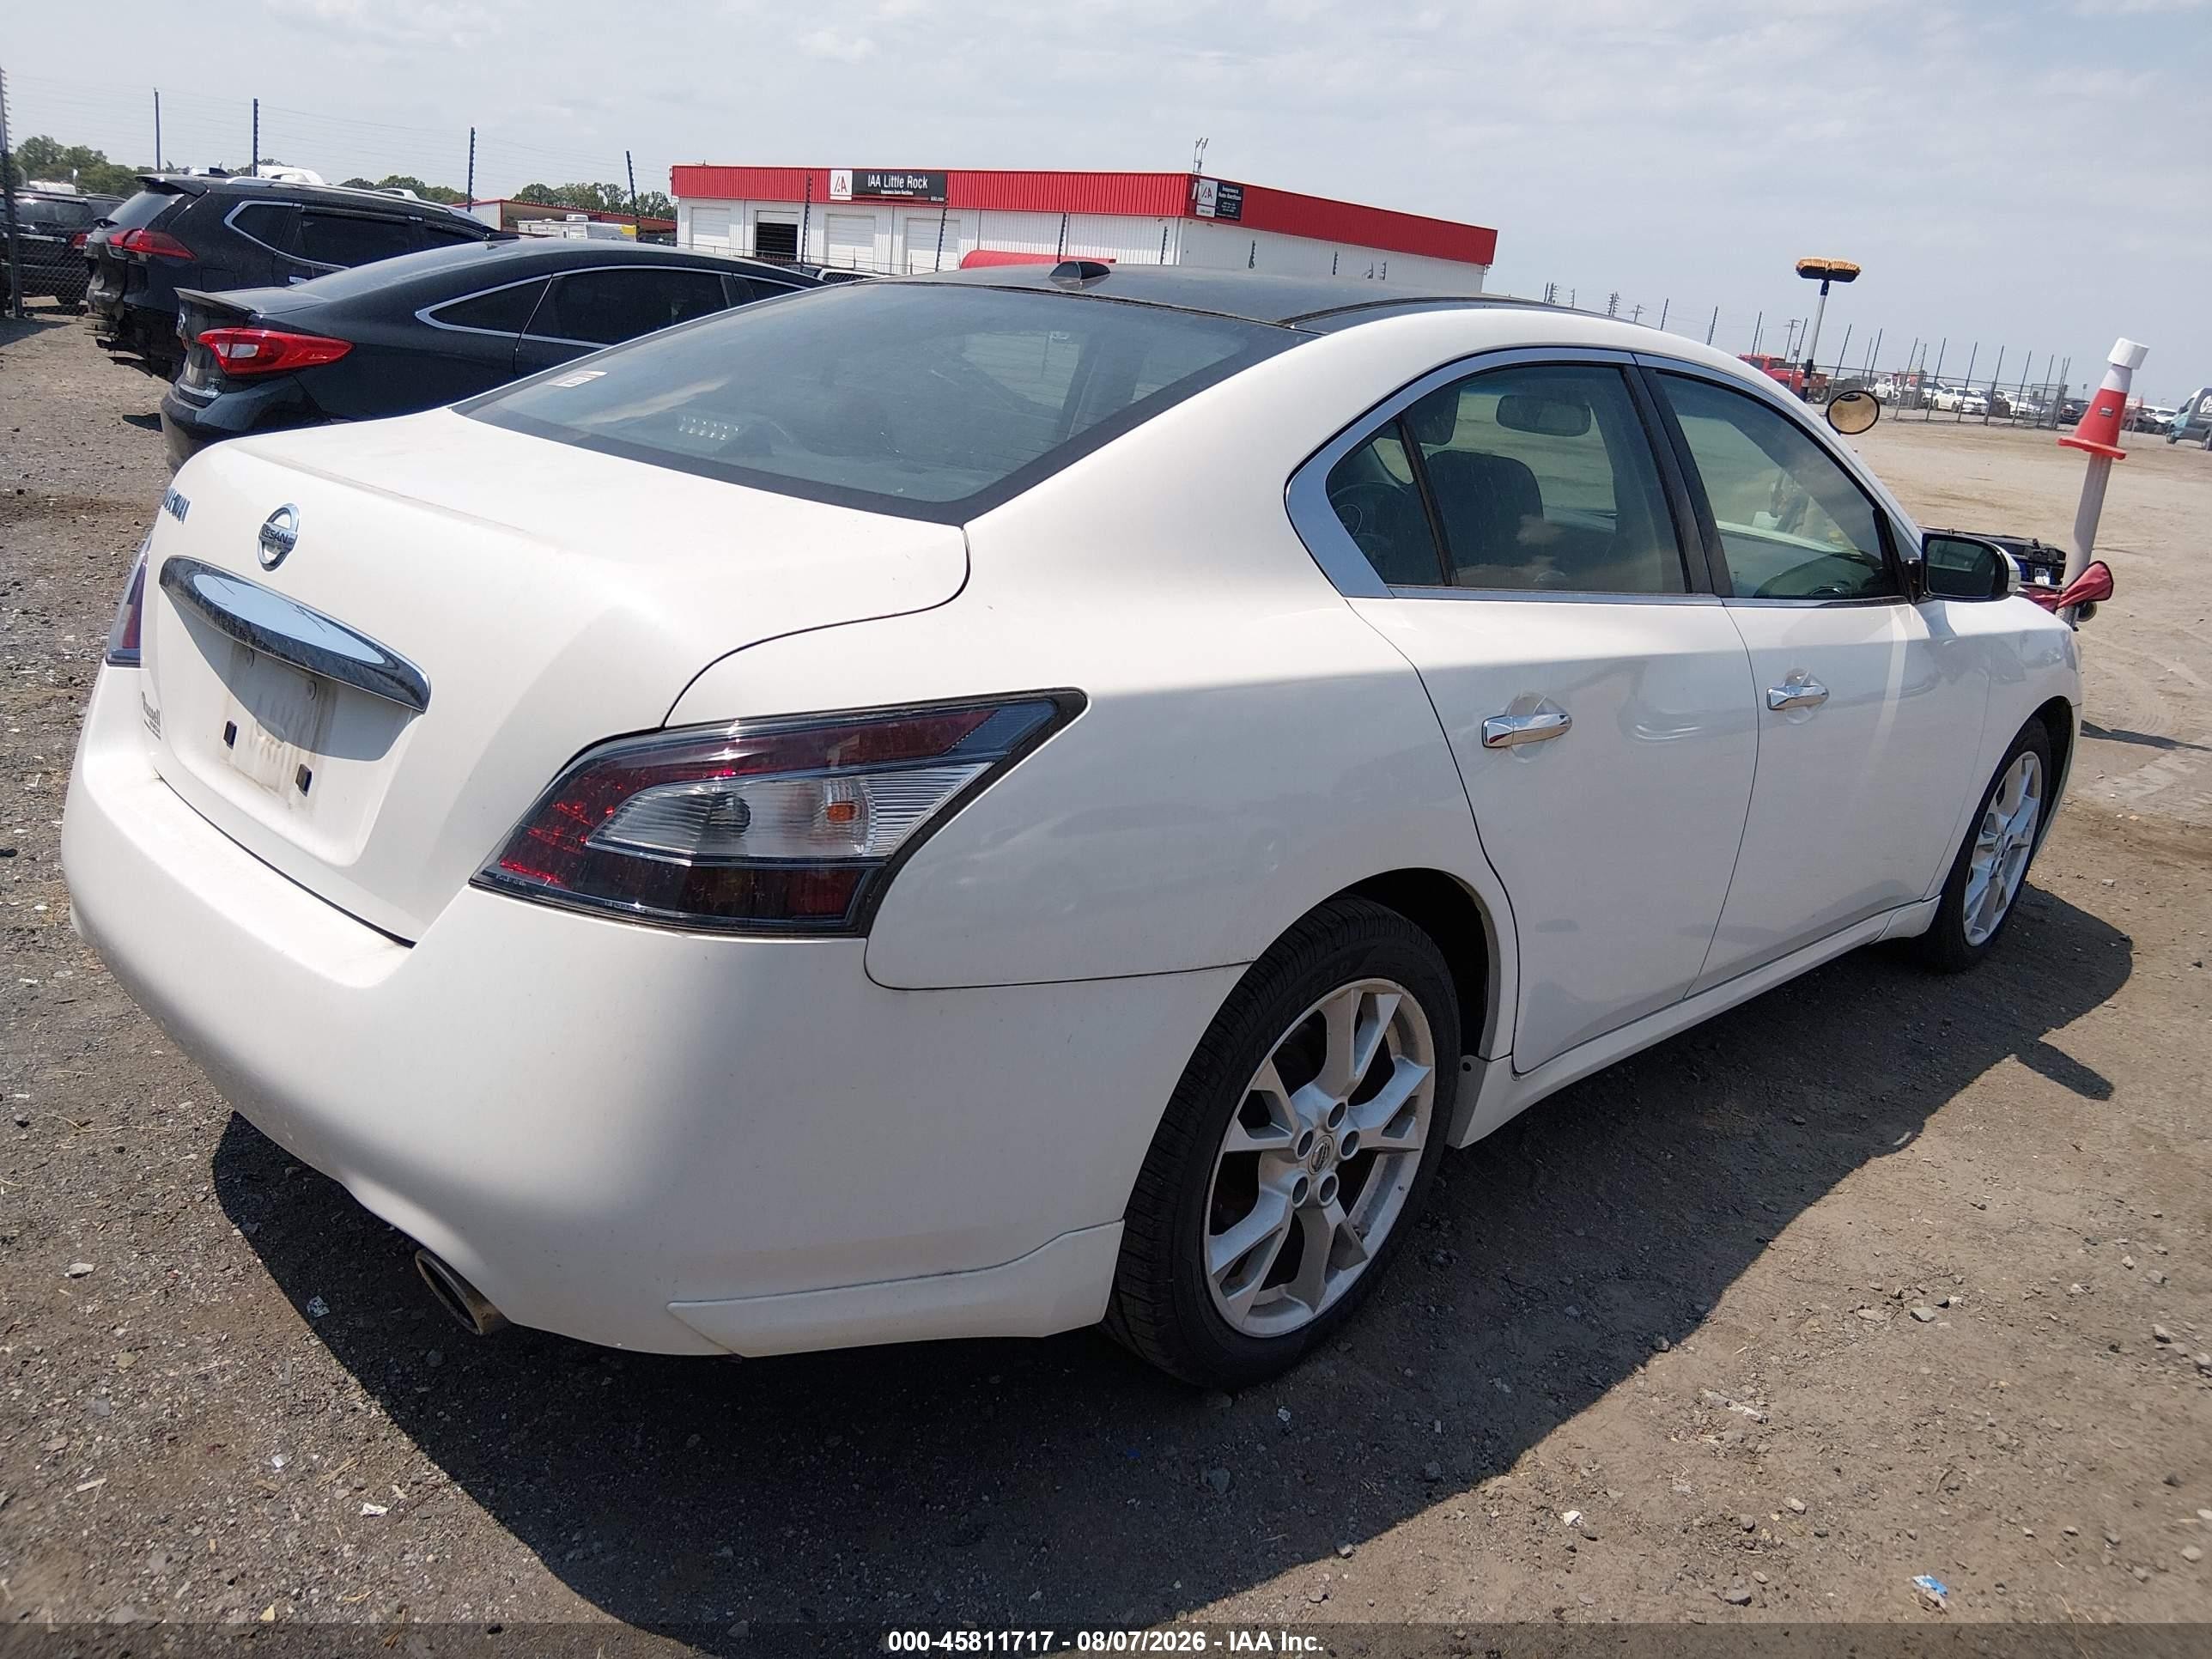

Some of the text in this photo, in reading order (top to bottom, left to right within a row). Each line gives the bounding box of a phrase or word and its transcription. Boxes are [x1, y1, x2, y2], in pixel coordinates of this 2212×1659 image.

[867, 174, 928, 189] IAA Little Rock
